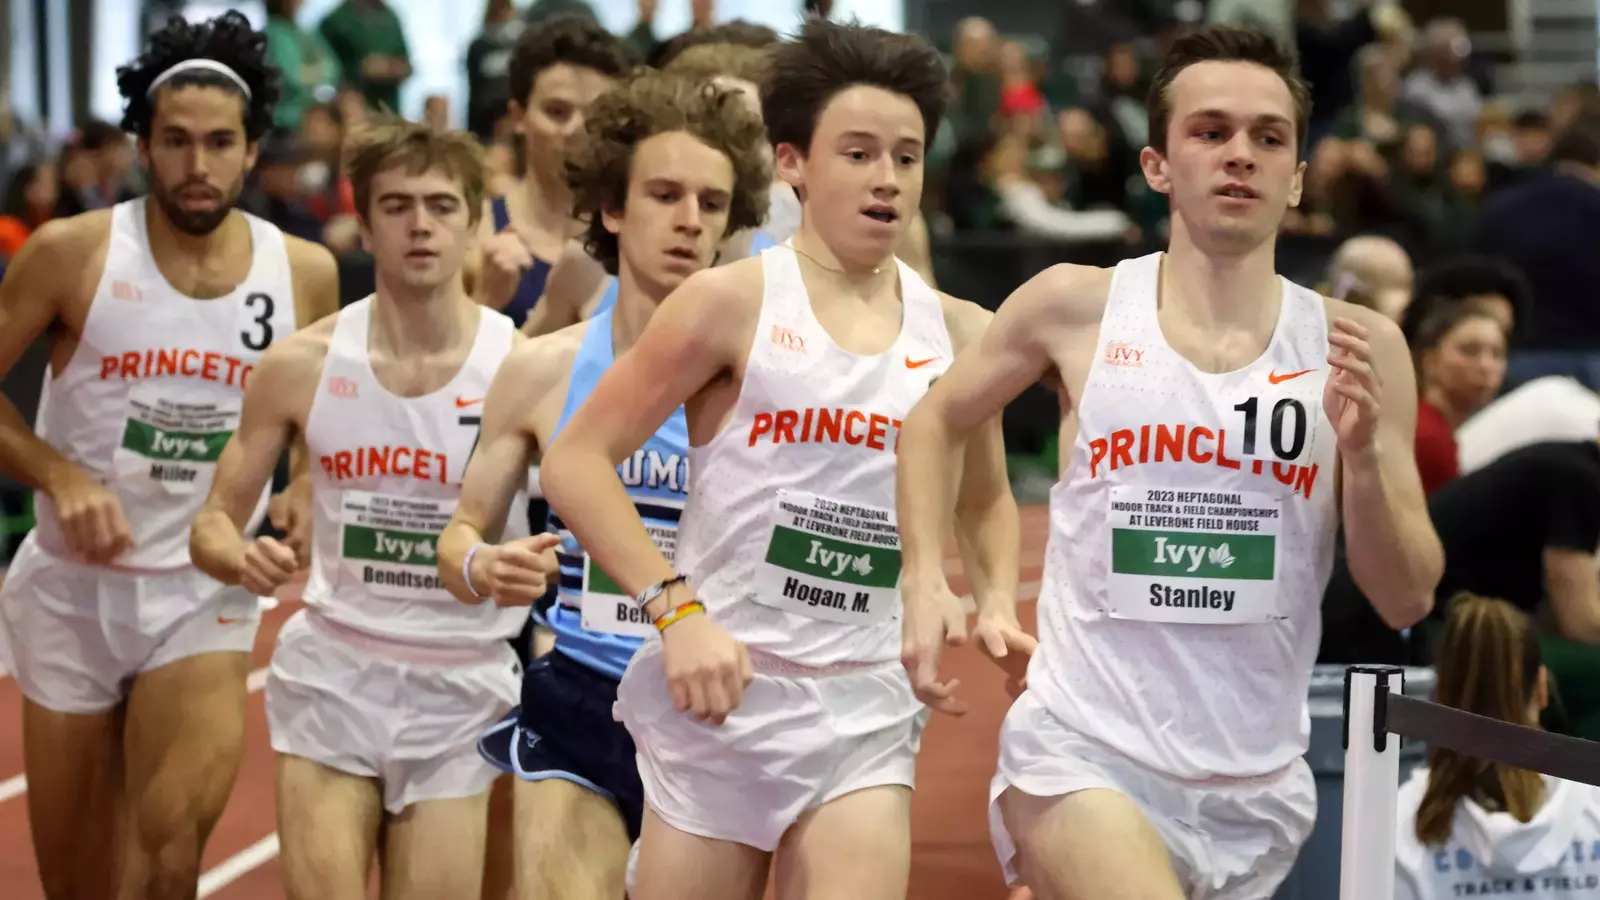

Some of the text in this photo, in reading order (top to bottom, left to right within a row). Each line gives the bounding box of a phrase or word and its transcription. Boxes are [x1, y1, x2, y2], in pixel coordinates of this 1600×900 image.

[241, 292, 274, 351] 3
[1234, 396, 1307, 461] 10
[151, 431, 191, 459] Ivy
[150, 463, 198, 482] Miller
[320, 445, 448, 485] PRINCET
[1088, 424, 1319, 500] PRINCEON
[814, 497, 839, 512] 2023
[1111, 502, 1143, 512] INDOOR
[1145, 503, 1173, 514] TRACK
[1183, 505, 1206, 515] FIELD
[1207, 507, 1279, 518] CHAMPIONSHIPS
[1147, 490, 1242, 505] 2023 HEPTAGONAL
[792, 516, 805, 527] AT
[1129, 515, 1259, 531] AT LEVERONE FIELD HOUSE
[375, 532, 414, 561] Ivy
[805, 540, 853, 576] Ivy
[1153, 537, 1207, 572] Ivy
[783, 577, 870, 613] Hogan, M.
[1149, 583, 1235, 611] Stanley
[1453, 880, 1514, 896] TRACK
[1542, 876, 1599, 890] FIELD
